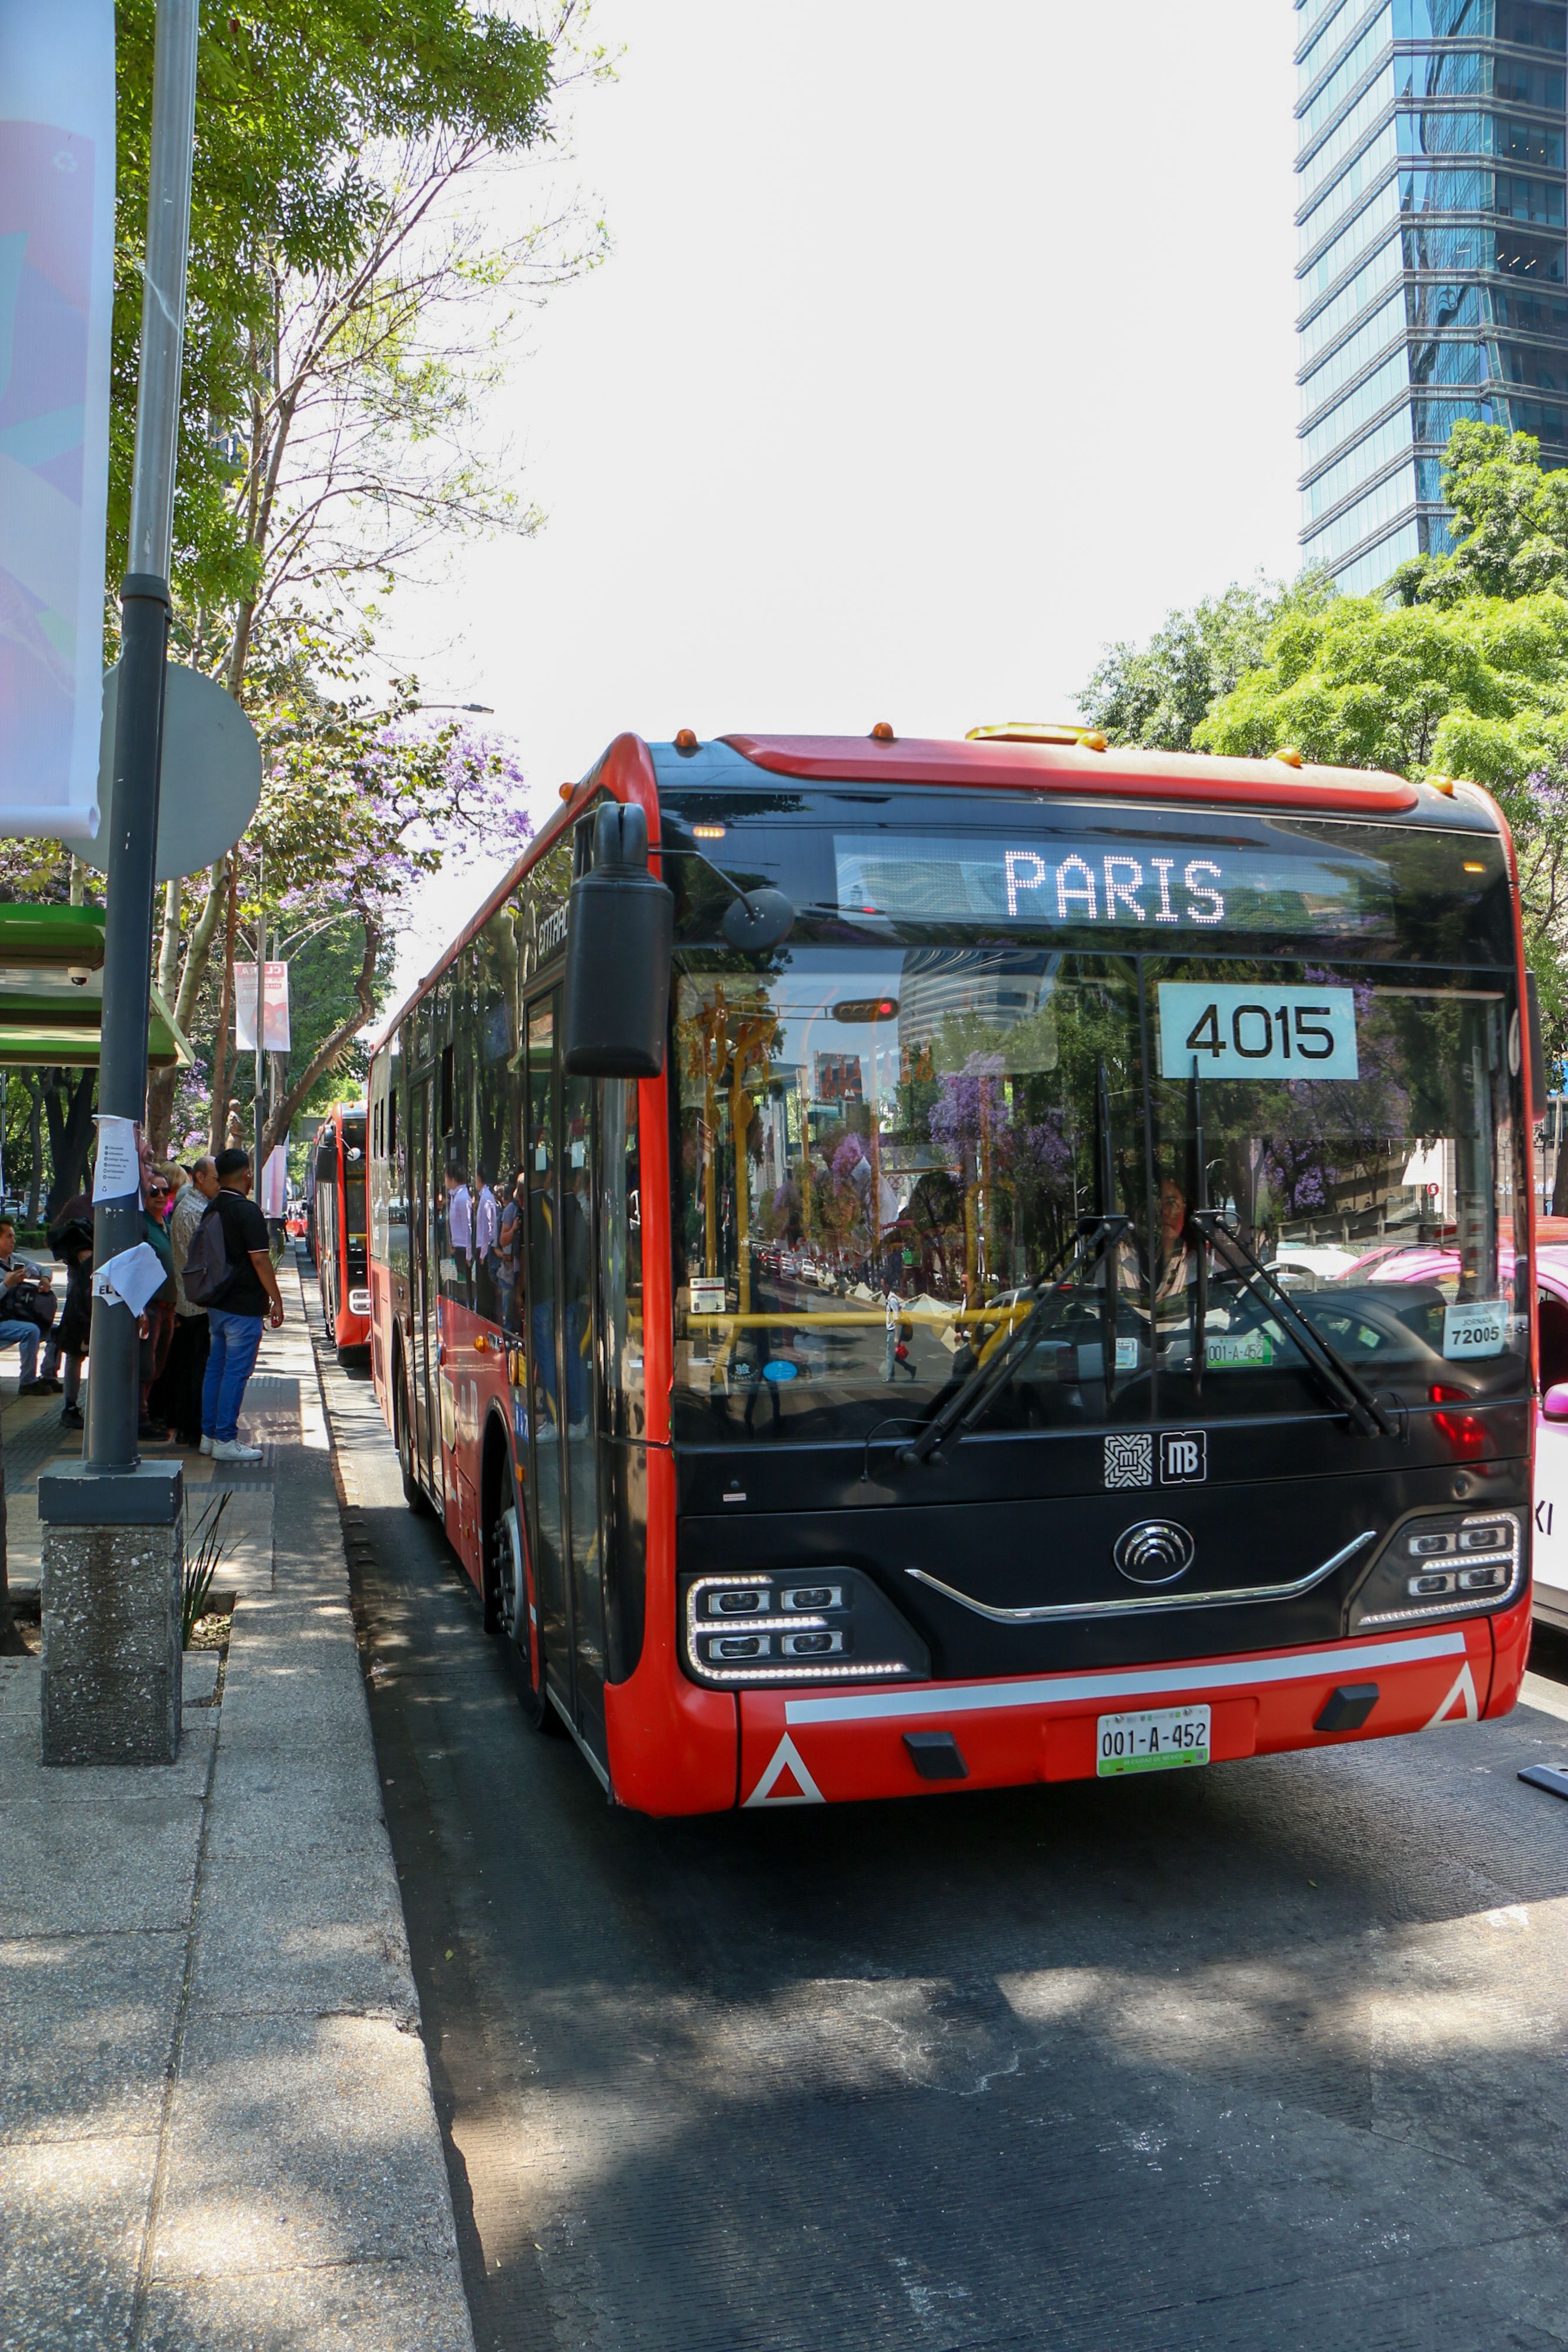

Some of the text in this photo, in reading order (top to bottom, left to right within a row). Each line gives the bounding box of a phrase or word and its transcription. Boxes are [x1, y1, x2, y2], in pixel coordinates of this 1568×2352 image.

[1005, 851, 1225, 924] PARIS
[1186, 1004, 1334, 1059] 4015
[1208, 1344, 1263, 1361] 001-A-452
[1452, 1326, 1500, 1345] 72005
[1103, 1723, 1206, 1757] 001-A-452
